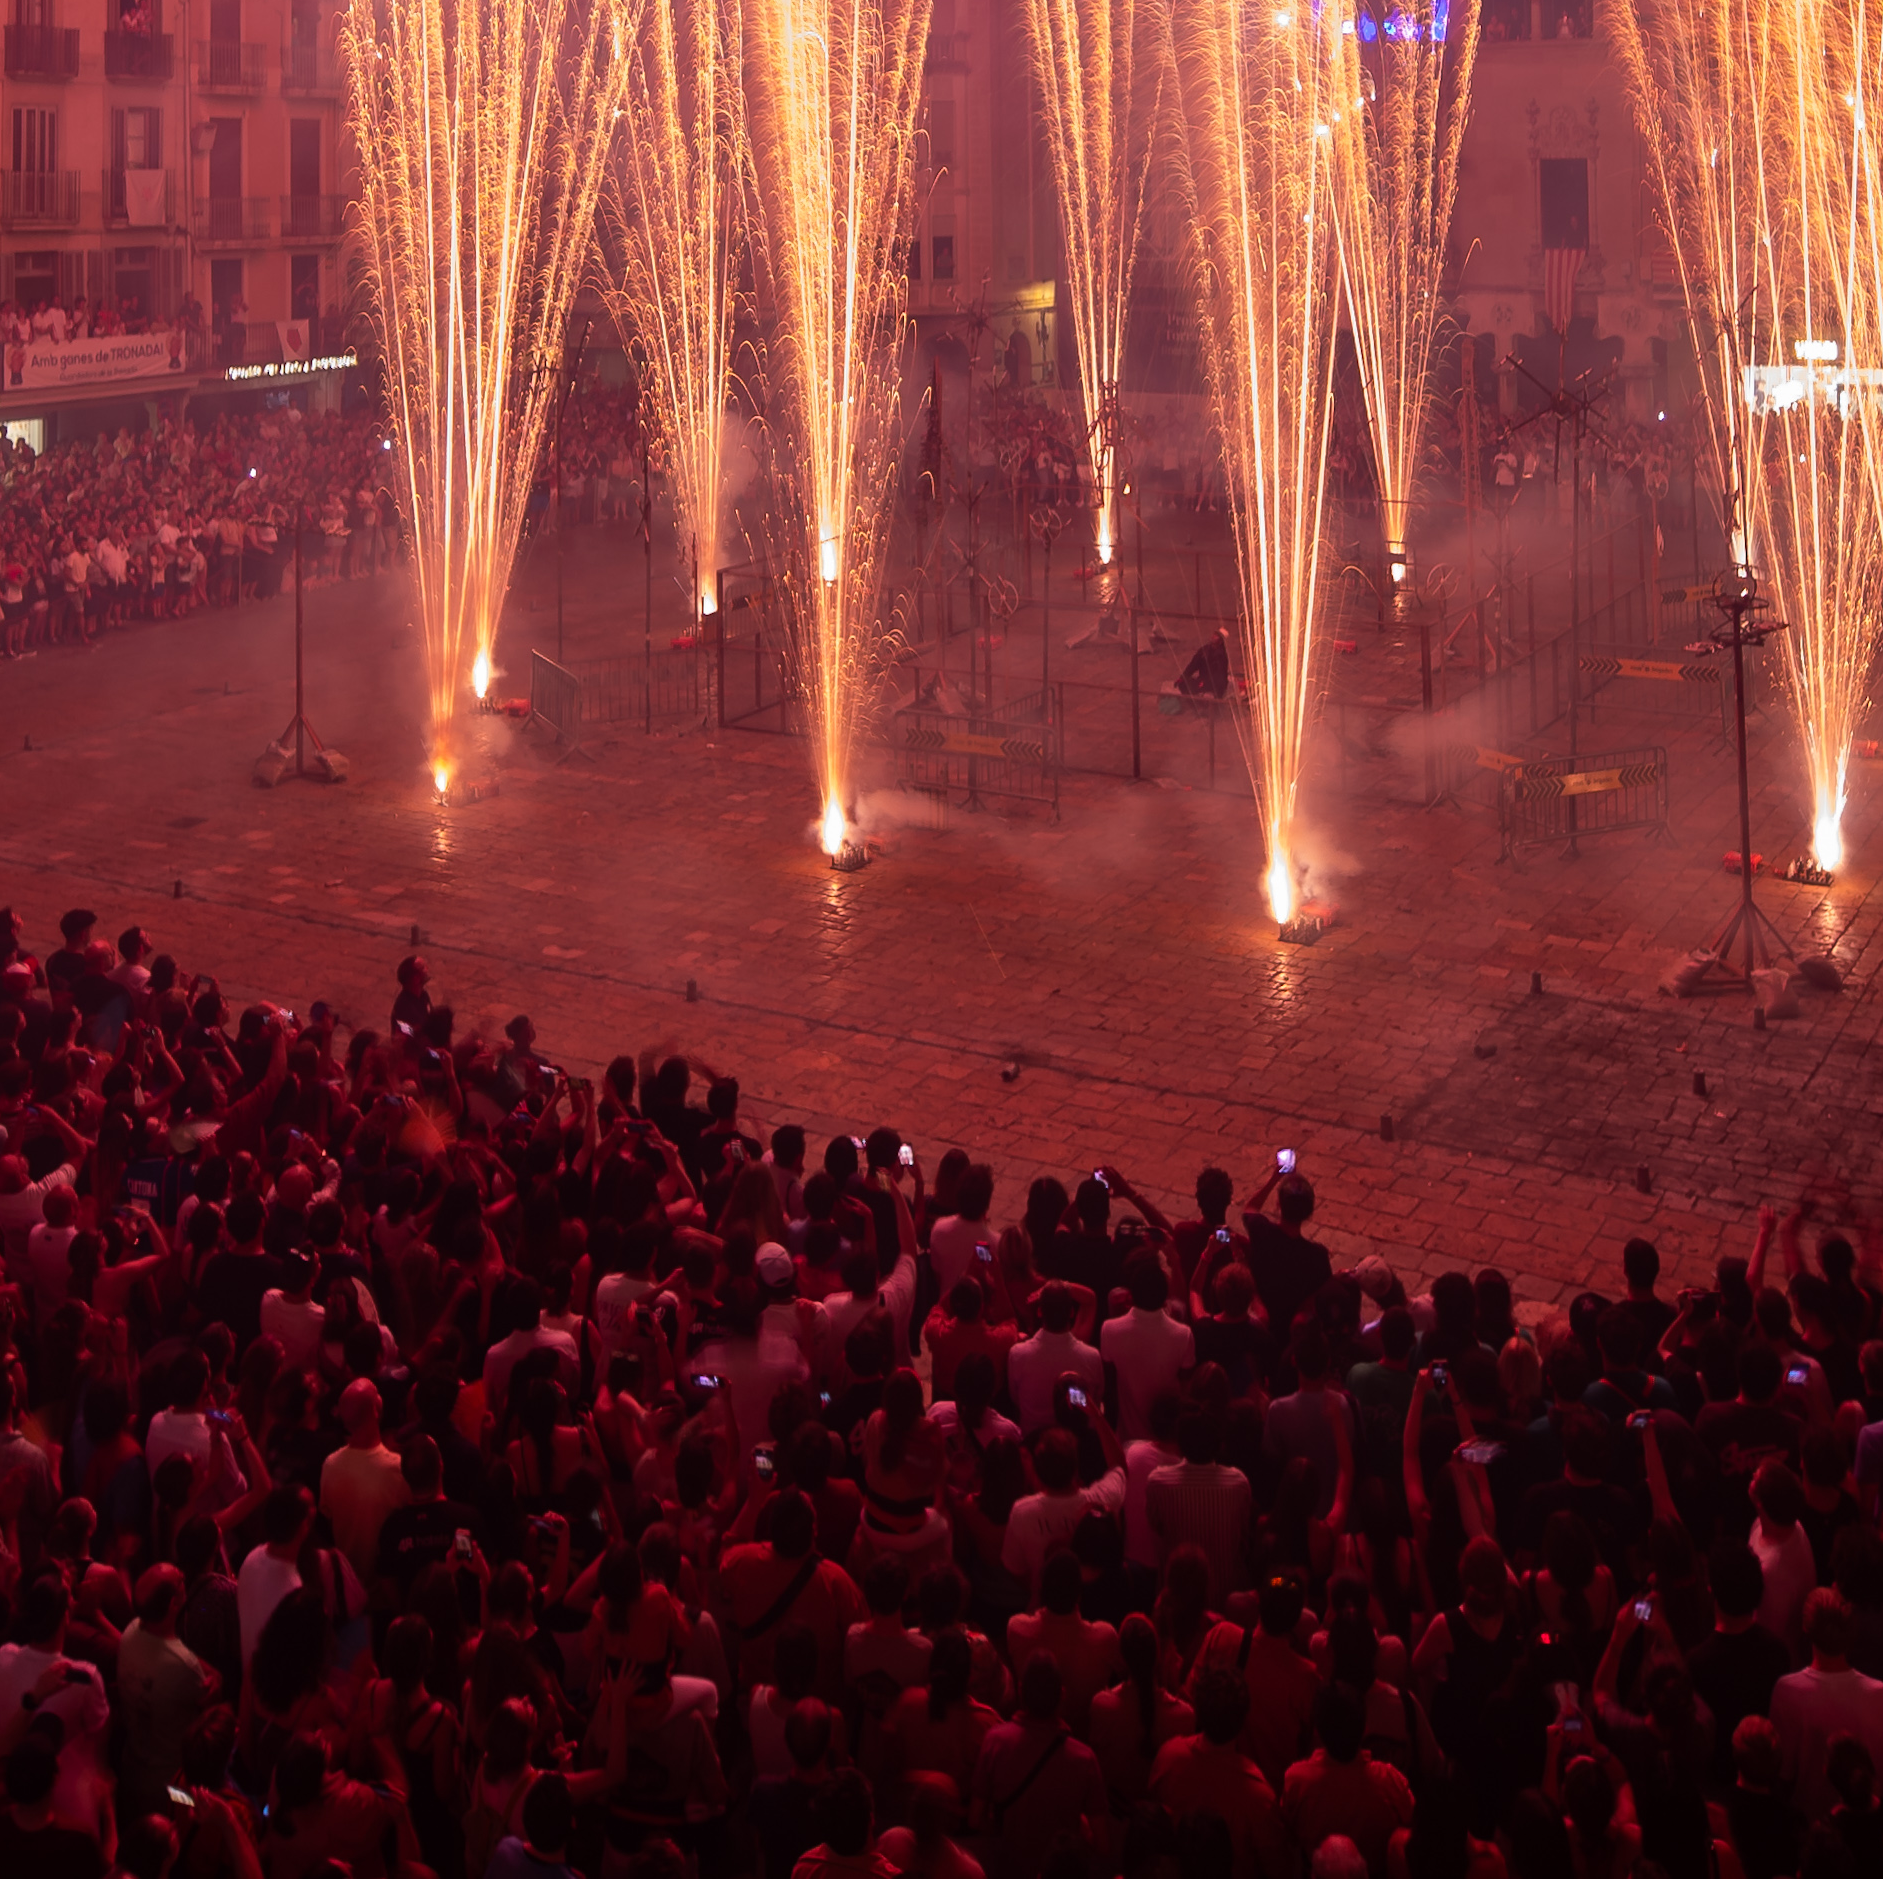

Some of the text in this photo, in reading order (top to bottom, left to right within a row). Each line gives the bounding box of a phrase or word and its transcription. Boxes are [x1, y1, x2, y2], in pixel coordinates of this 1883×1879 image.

[31, 354, 58, 368] Amb
[60, 353, 93, 370] ganes
[95, 349, 109, 363] de
